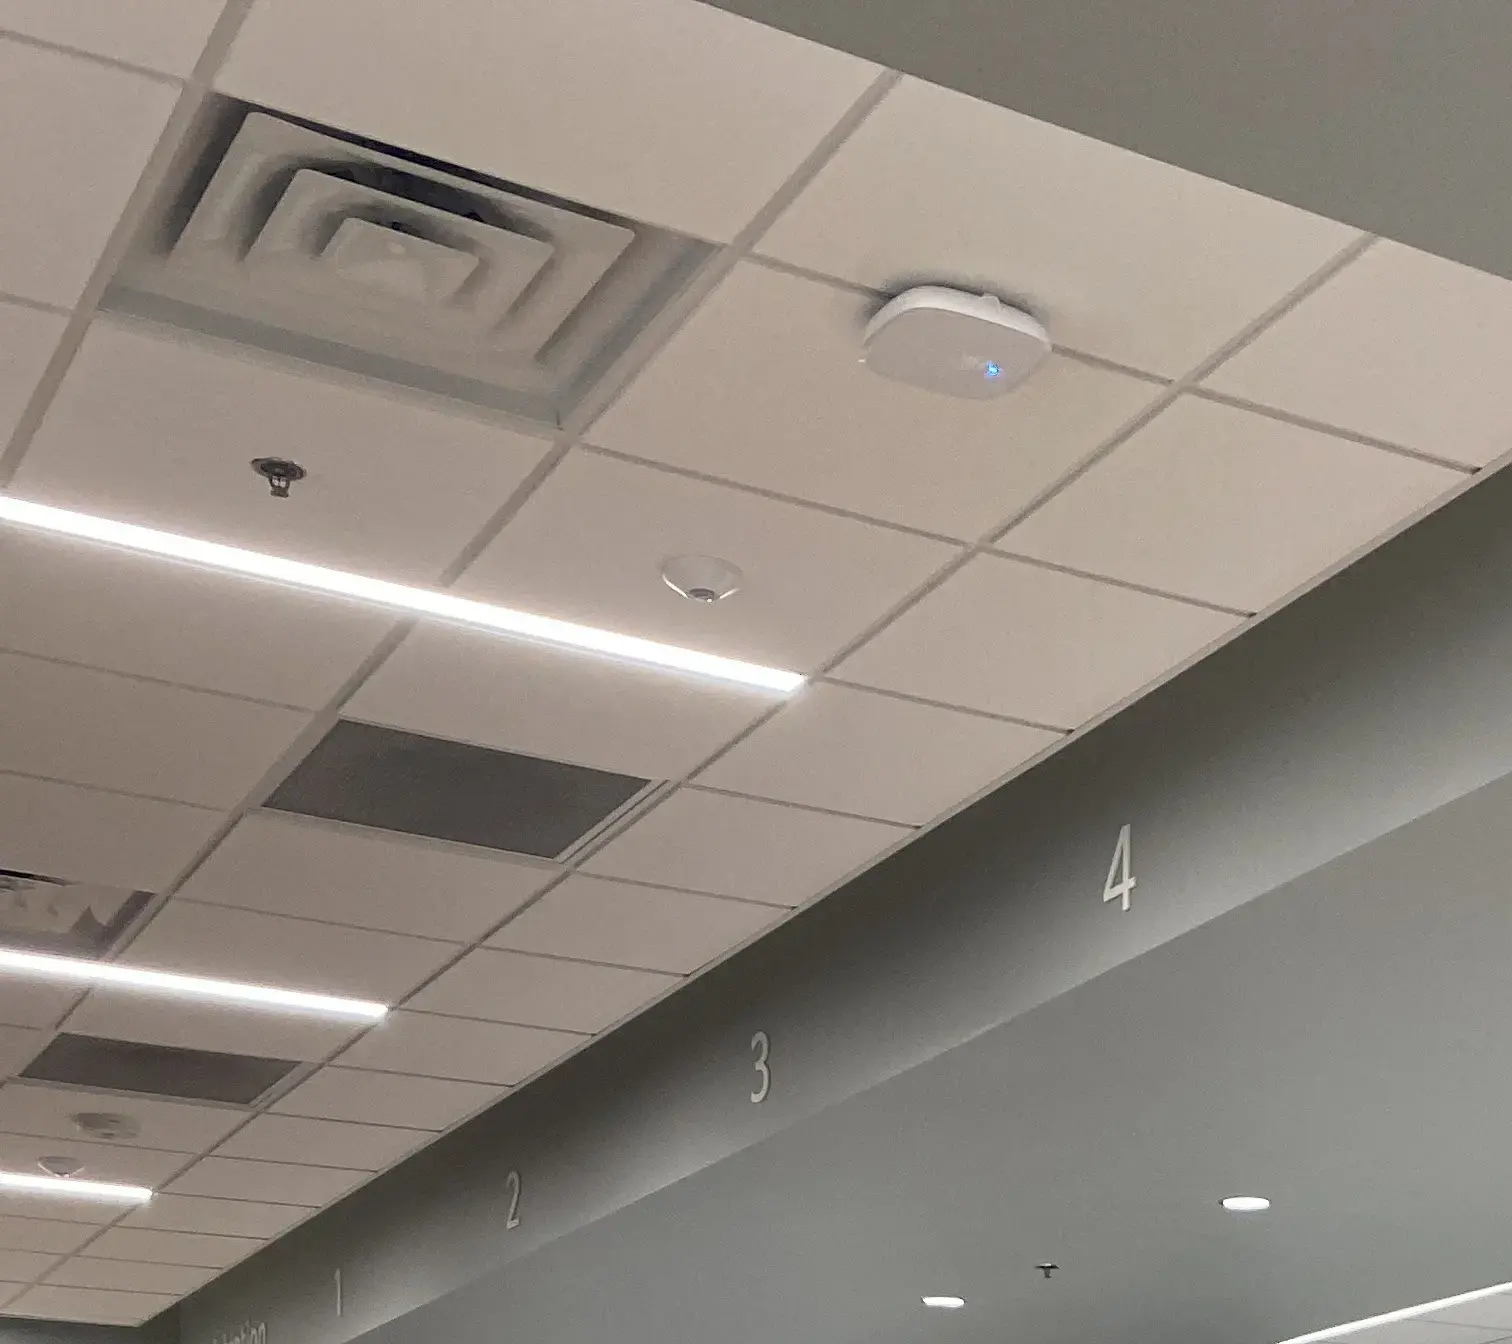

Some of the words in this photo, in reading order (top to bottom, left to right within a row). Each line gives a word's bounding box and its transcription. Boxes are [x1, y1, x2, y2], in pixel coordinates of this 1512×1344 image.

[1103, 823, 1137, 912] 4
[750, 1031, 771, 1104] 3
[506, 1169, 522, 1230] 2
[334, 1267, 343, 1317] 1
